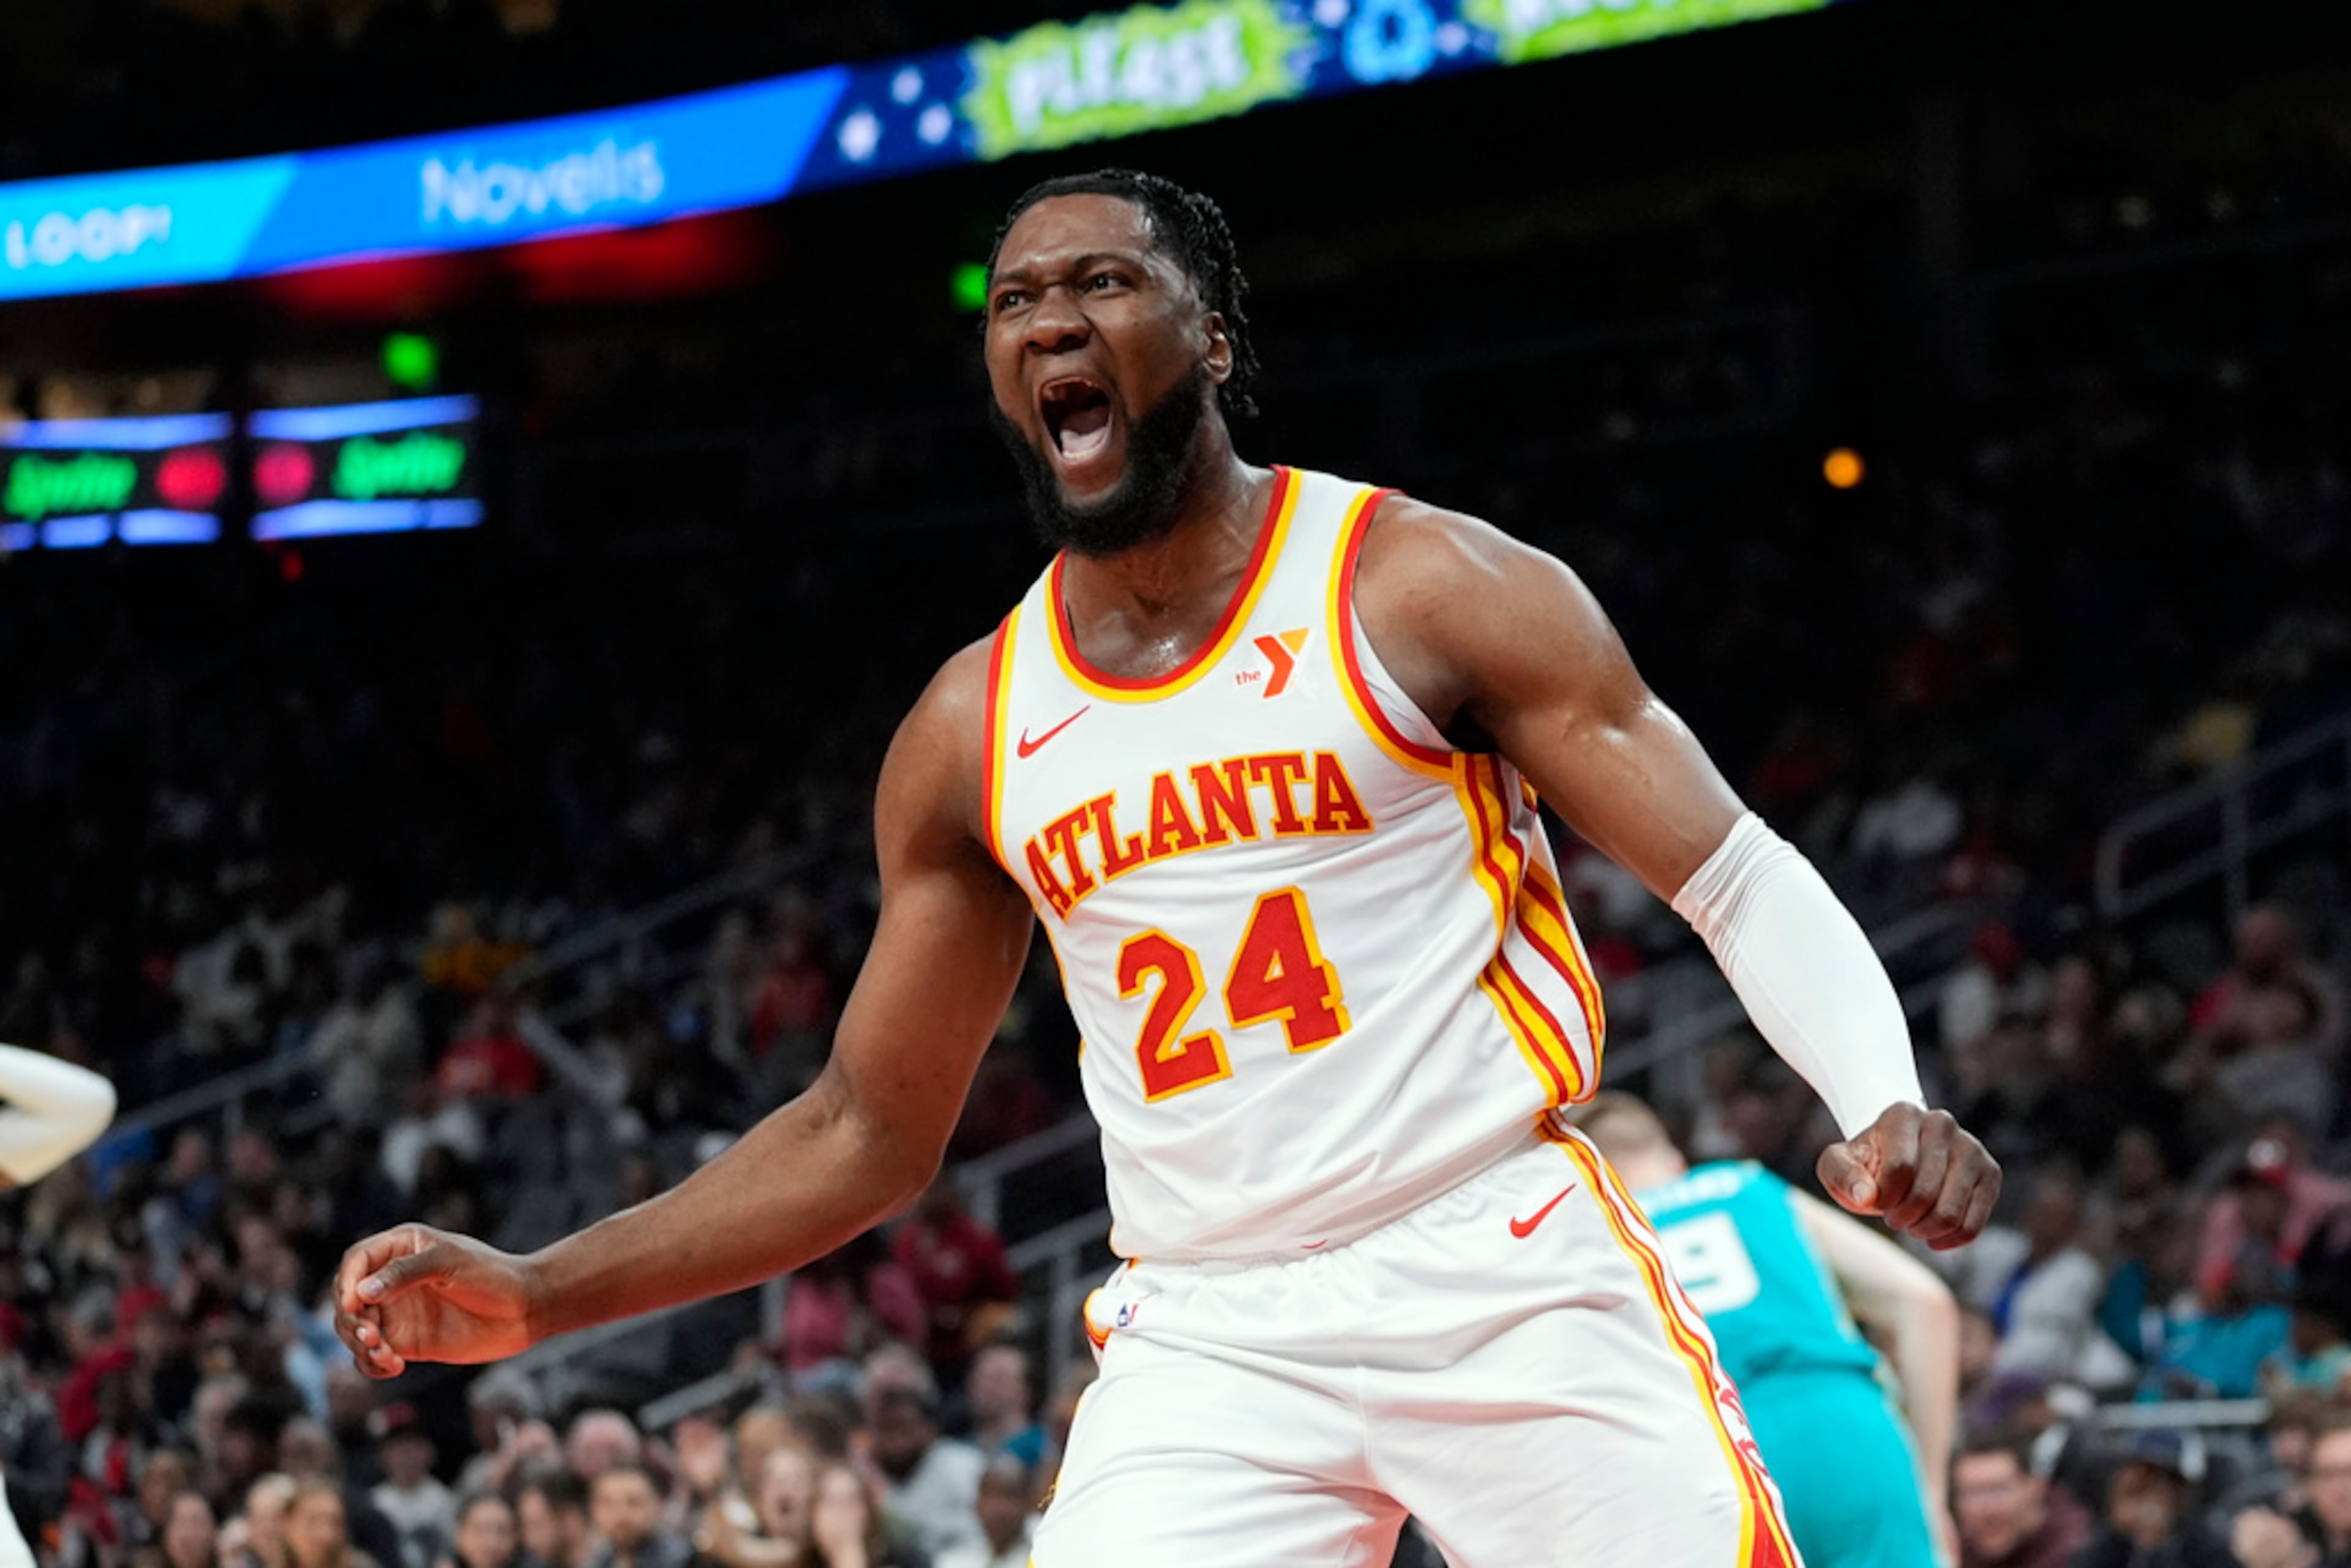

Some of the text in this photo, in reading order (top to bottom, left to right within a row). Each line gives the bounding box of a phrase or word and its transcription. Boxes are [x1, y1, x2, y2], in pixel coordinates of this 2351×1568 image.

[1007, 13, 1250, 133] PLEASE
[422, 138, 665, 223] Novelis
[1235, 671, 1261, 685] the
[1024, 751, 1374, 923] ATLANTA
[1117, 885, 1352, 1103] 24
